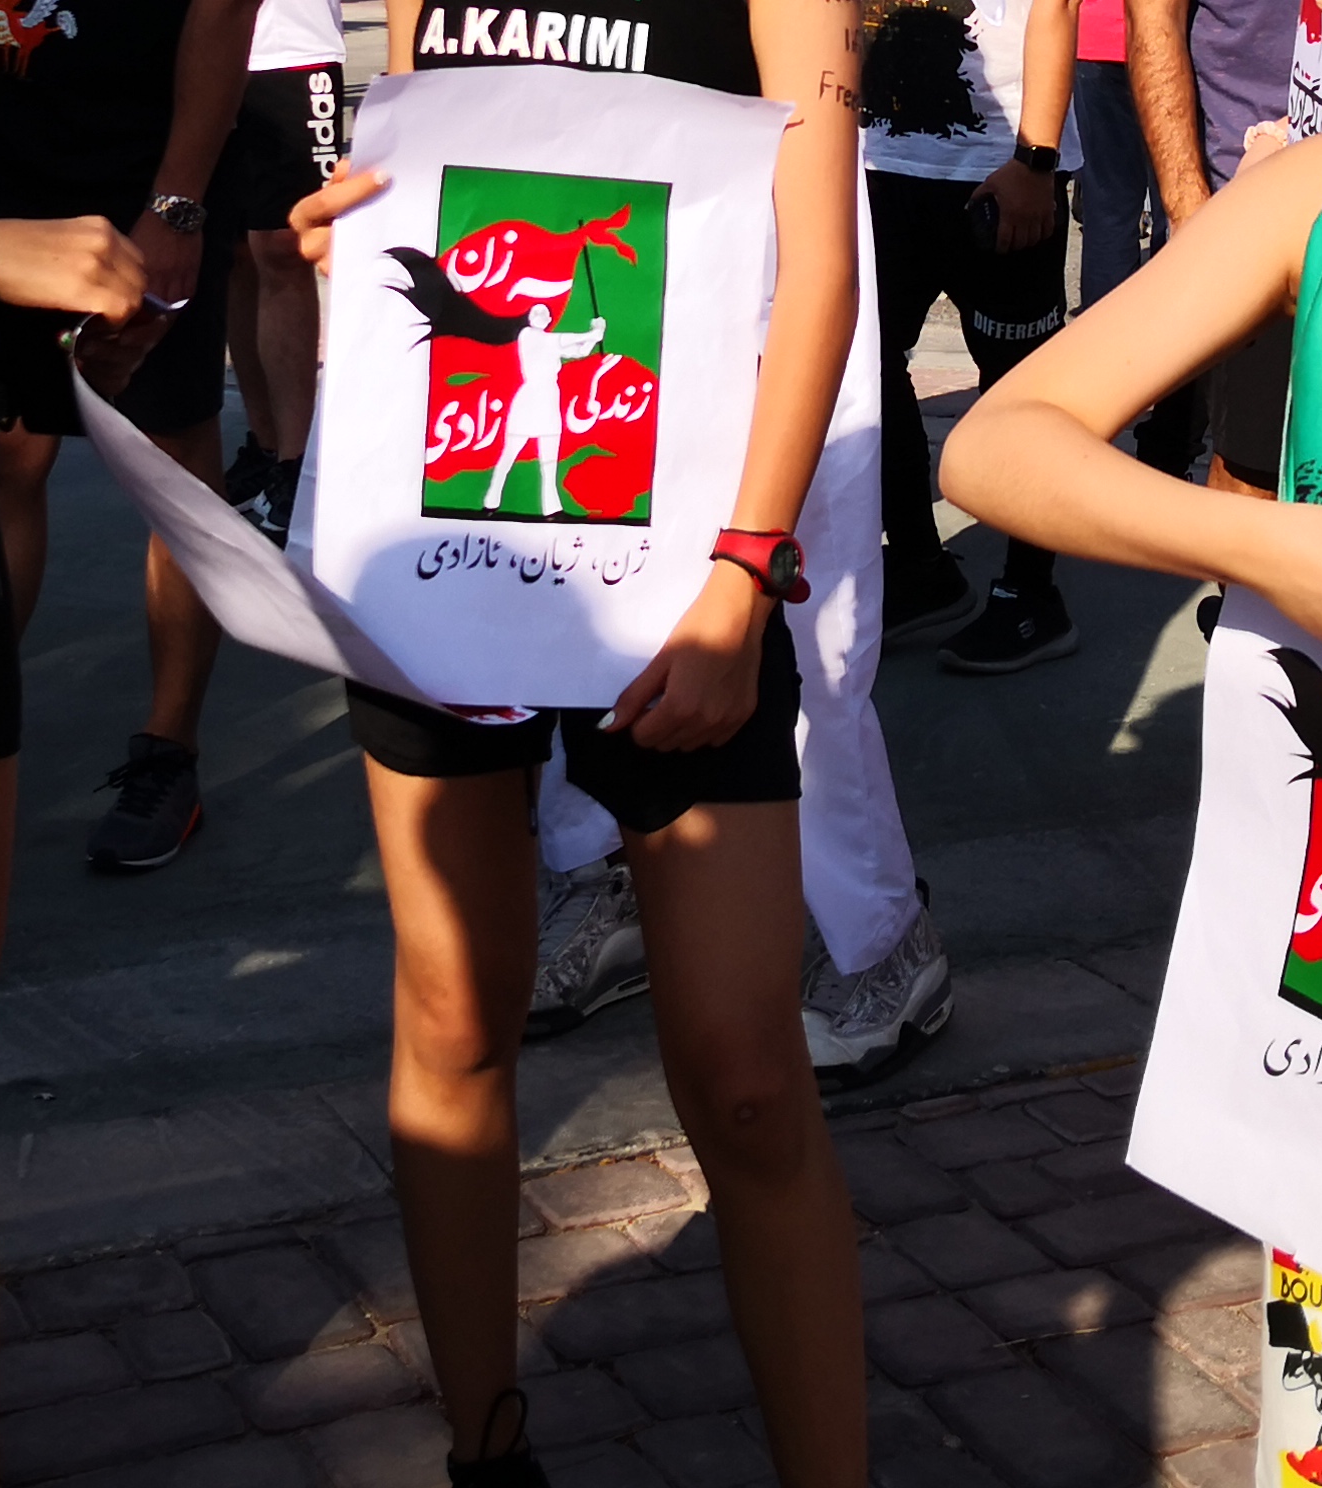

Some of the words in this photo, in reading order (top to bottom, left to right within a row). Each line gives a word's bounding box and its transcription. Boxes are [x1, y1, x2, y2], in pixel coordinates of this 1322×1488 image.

[419, 6, 650, 72] A.KARIMI
[306, 71, 339, 189] didas
[446, 230, 518, 293] زن
[973, 305, 1061, 340] DIFFERENCE
[566, 353, 653, 434] زندگی
